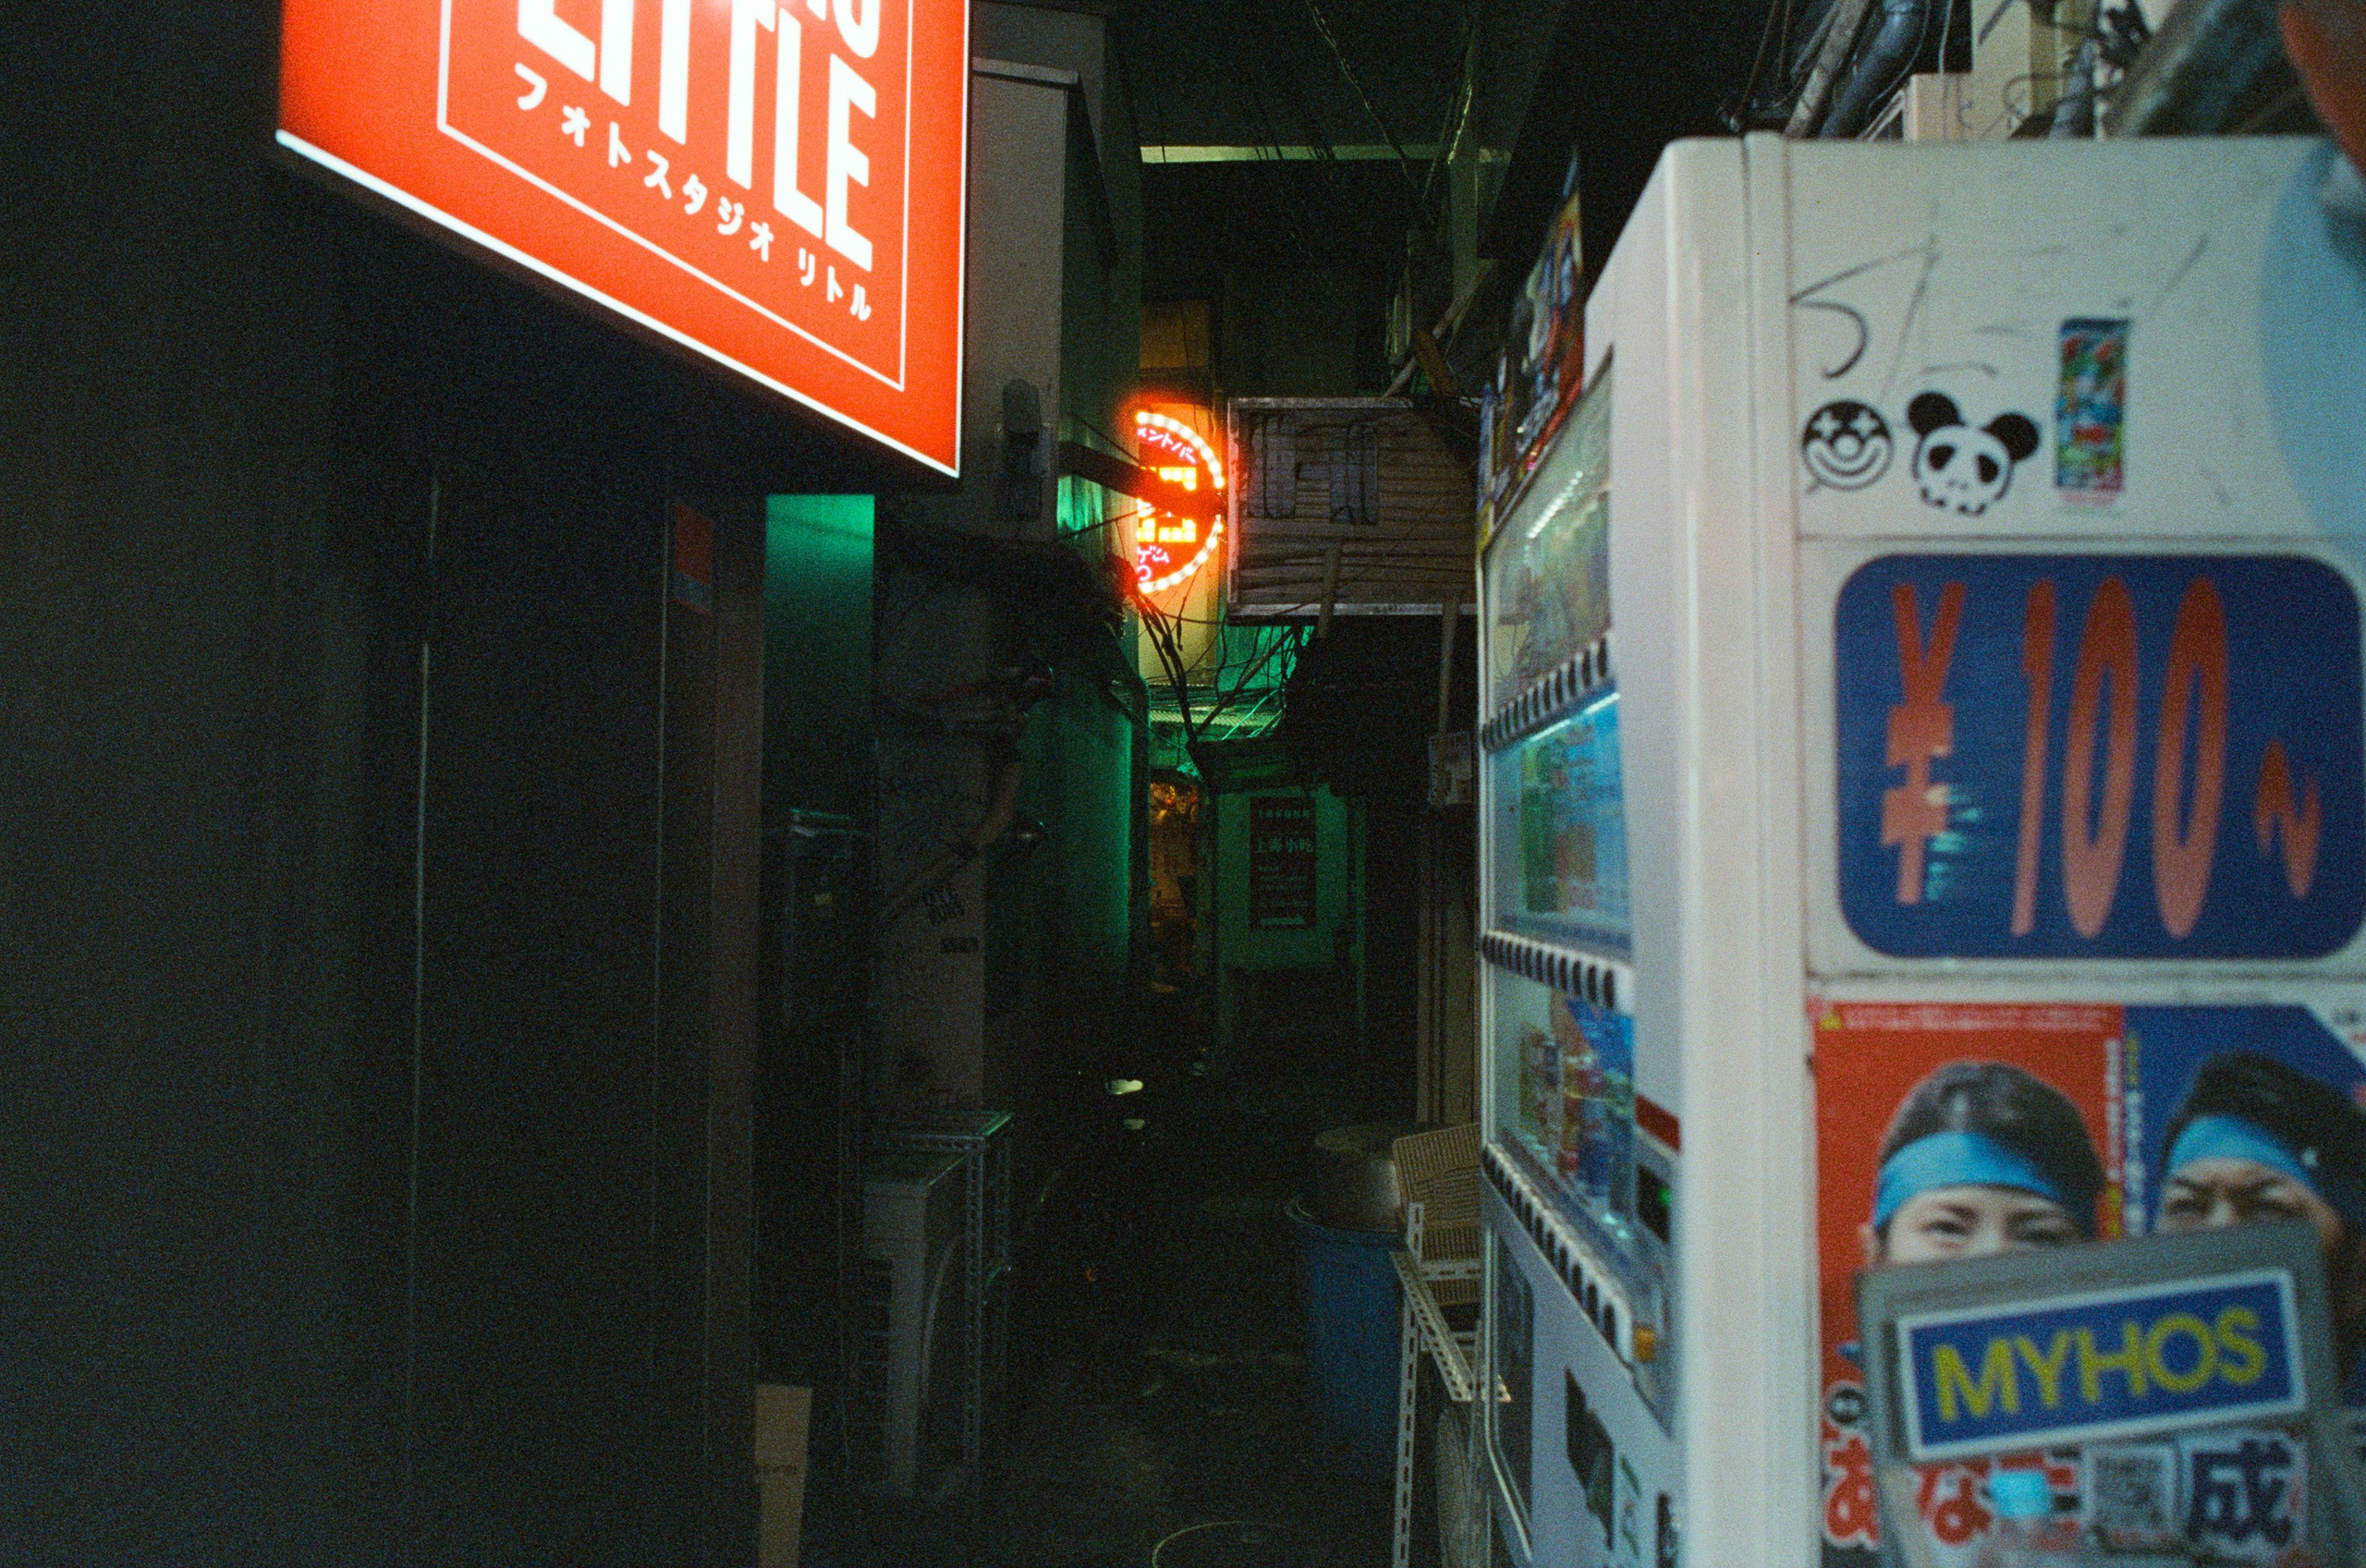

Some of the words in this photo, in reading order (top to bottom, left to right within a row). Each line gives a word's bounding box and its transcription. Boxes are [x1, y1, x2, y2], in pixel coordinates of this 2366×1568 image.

[798, 247, 872, 322] リトル
[1931, 1307, 2267, 1422] MYHOS
